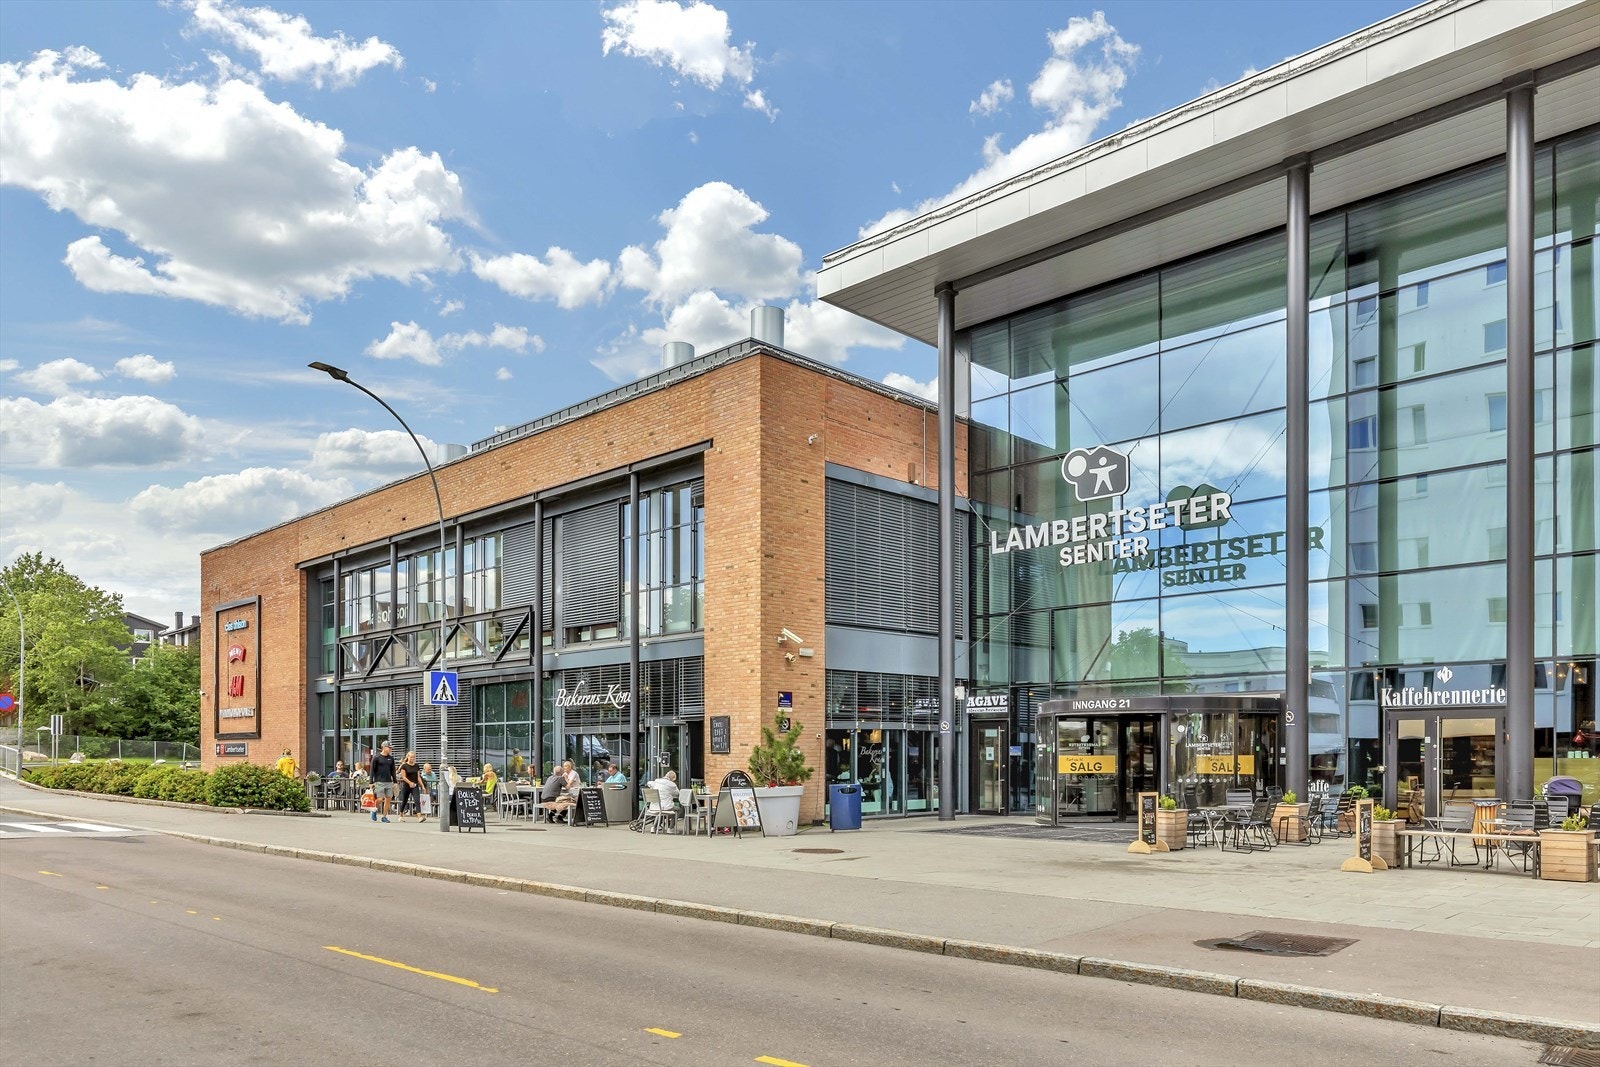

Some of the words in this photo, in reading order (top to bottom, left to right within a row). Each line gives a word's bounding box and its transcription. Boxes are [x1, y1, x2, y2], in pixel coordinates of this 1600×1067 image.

[990, 491, 1232, 555] LAMBERTSETER
[1059, 536, 1149, 567] SENTER
[1162, 562, 1247, 588] SENTER
[555, 680, 600, 707] Bakerens
[966, 695, 1008, 707] AGAVE
[1072, 699, 1117, 710] INNGANG
[1118, 699, 1131, 708] 21
[1070, 762, 1103, 772] SALG
[464, 798, 480, 808] FEST
